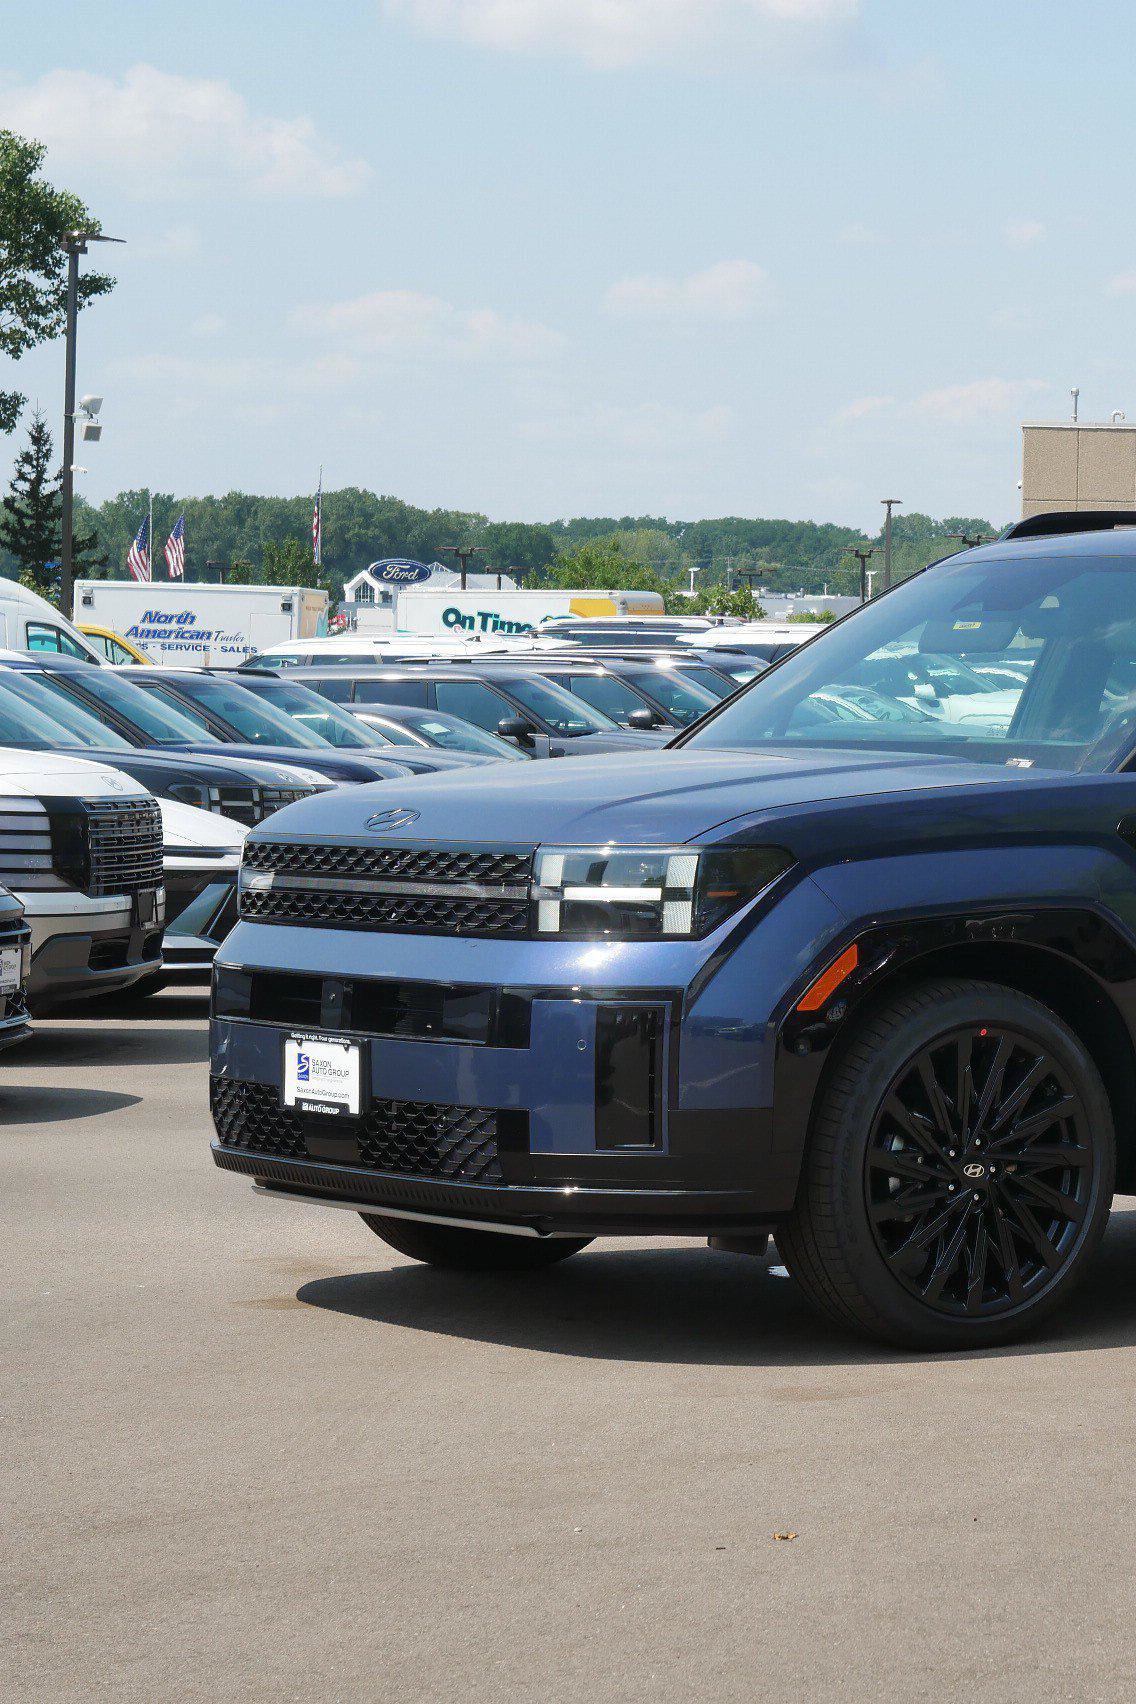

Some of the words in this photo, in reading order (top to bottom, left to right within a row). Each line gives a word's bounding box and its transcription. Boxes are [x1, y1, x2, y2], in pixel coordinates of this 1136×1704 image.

[382, 564, 419, 580] Ford
[140, 609, 196, 625] North
[442, 606, 472, 632] On
[124, 625, 213, 641] American
[160, 643, 211, 652] SERVICE
[220, 645, 258, 654] SALES
[311, 1058, 332, 1069] SAXON
[311, 1067, 328, 1076] AUTO
[328, 1068, 350, 1078] GROUP
